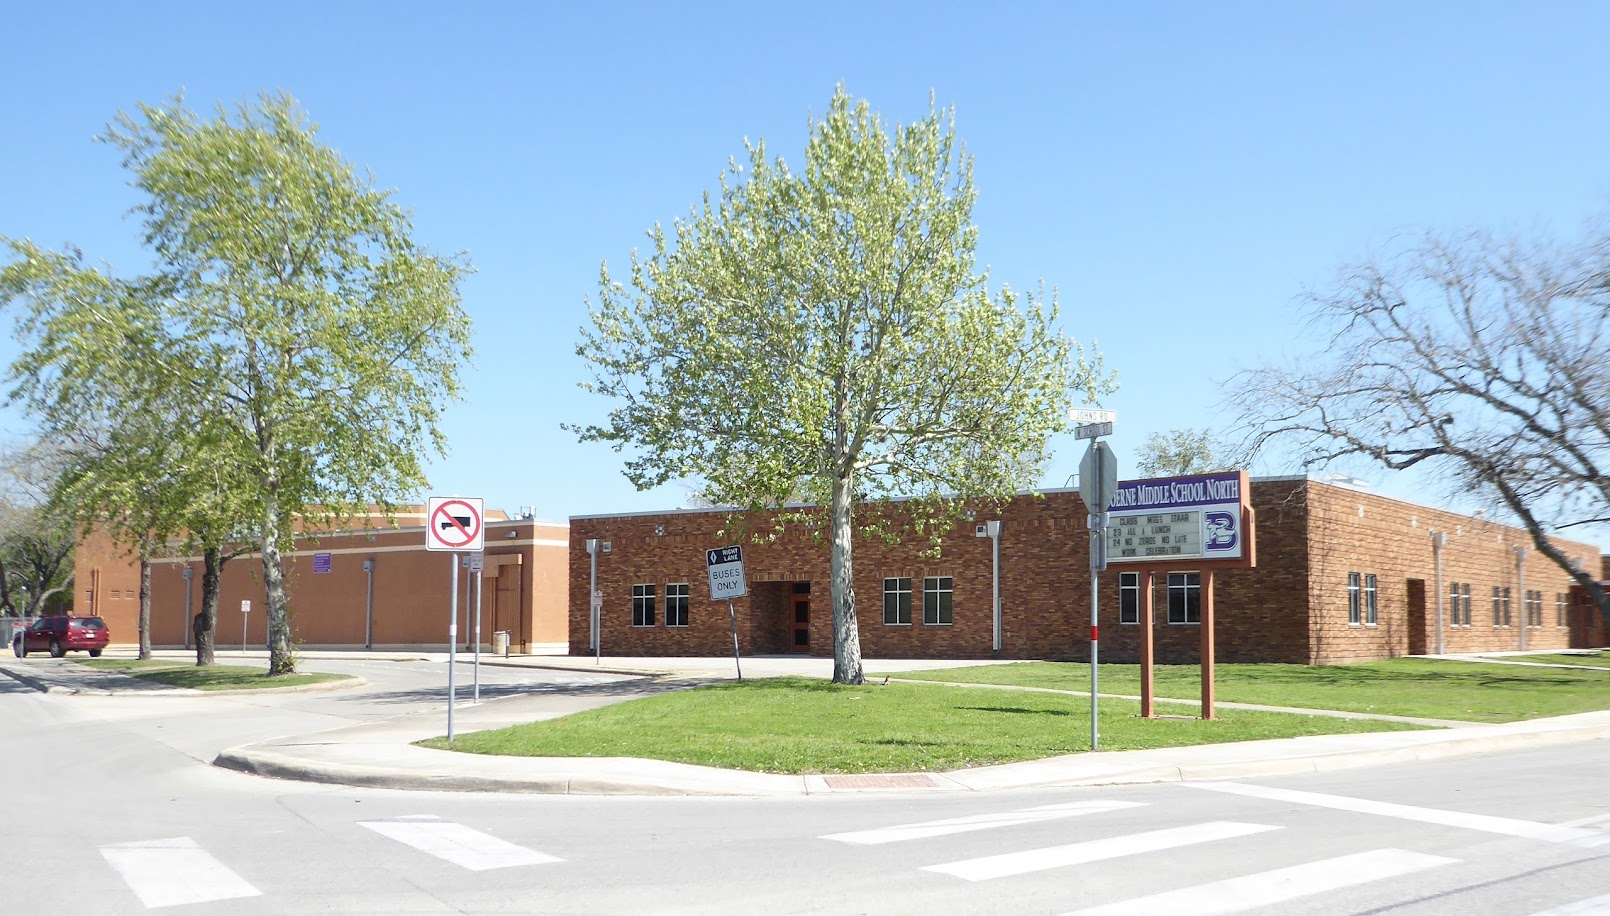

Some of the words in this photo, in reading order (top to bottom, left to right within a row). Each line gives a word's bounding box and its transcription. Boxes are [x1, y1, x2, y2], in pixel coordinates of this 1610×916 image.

[1076, 411, 1097, 420] JOHNS
[1100, 412, 1108, 421] RD
[1103, 424, 1108, 434] ST
[1111, 488, 1136, 507] OERNE
[1137, 484, 1170, 506] MIDDLE
[1170, 482, 1206, 504] SCHOOL
[1206, 479, 1238, 500] NORTH
[1120, 518, 1138, 526] CLASS
[1170, 514, 1189, 522] STAAR
[1113, 528, 1122, 536] 23
[1151, 526, 1171, 534] LUNCH
[1113, 538, 1120, 546] 24
[1138, 536, 1156, 545] ZEROS
[1174, 535, 1187, 544] LATE
[1146, 546, 1182, 556] CELEBRATION
[713, 568, 740, 580] BUSES
[718, 580, 738, 590] ONLY
